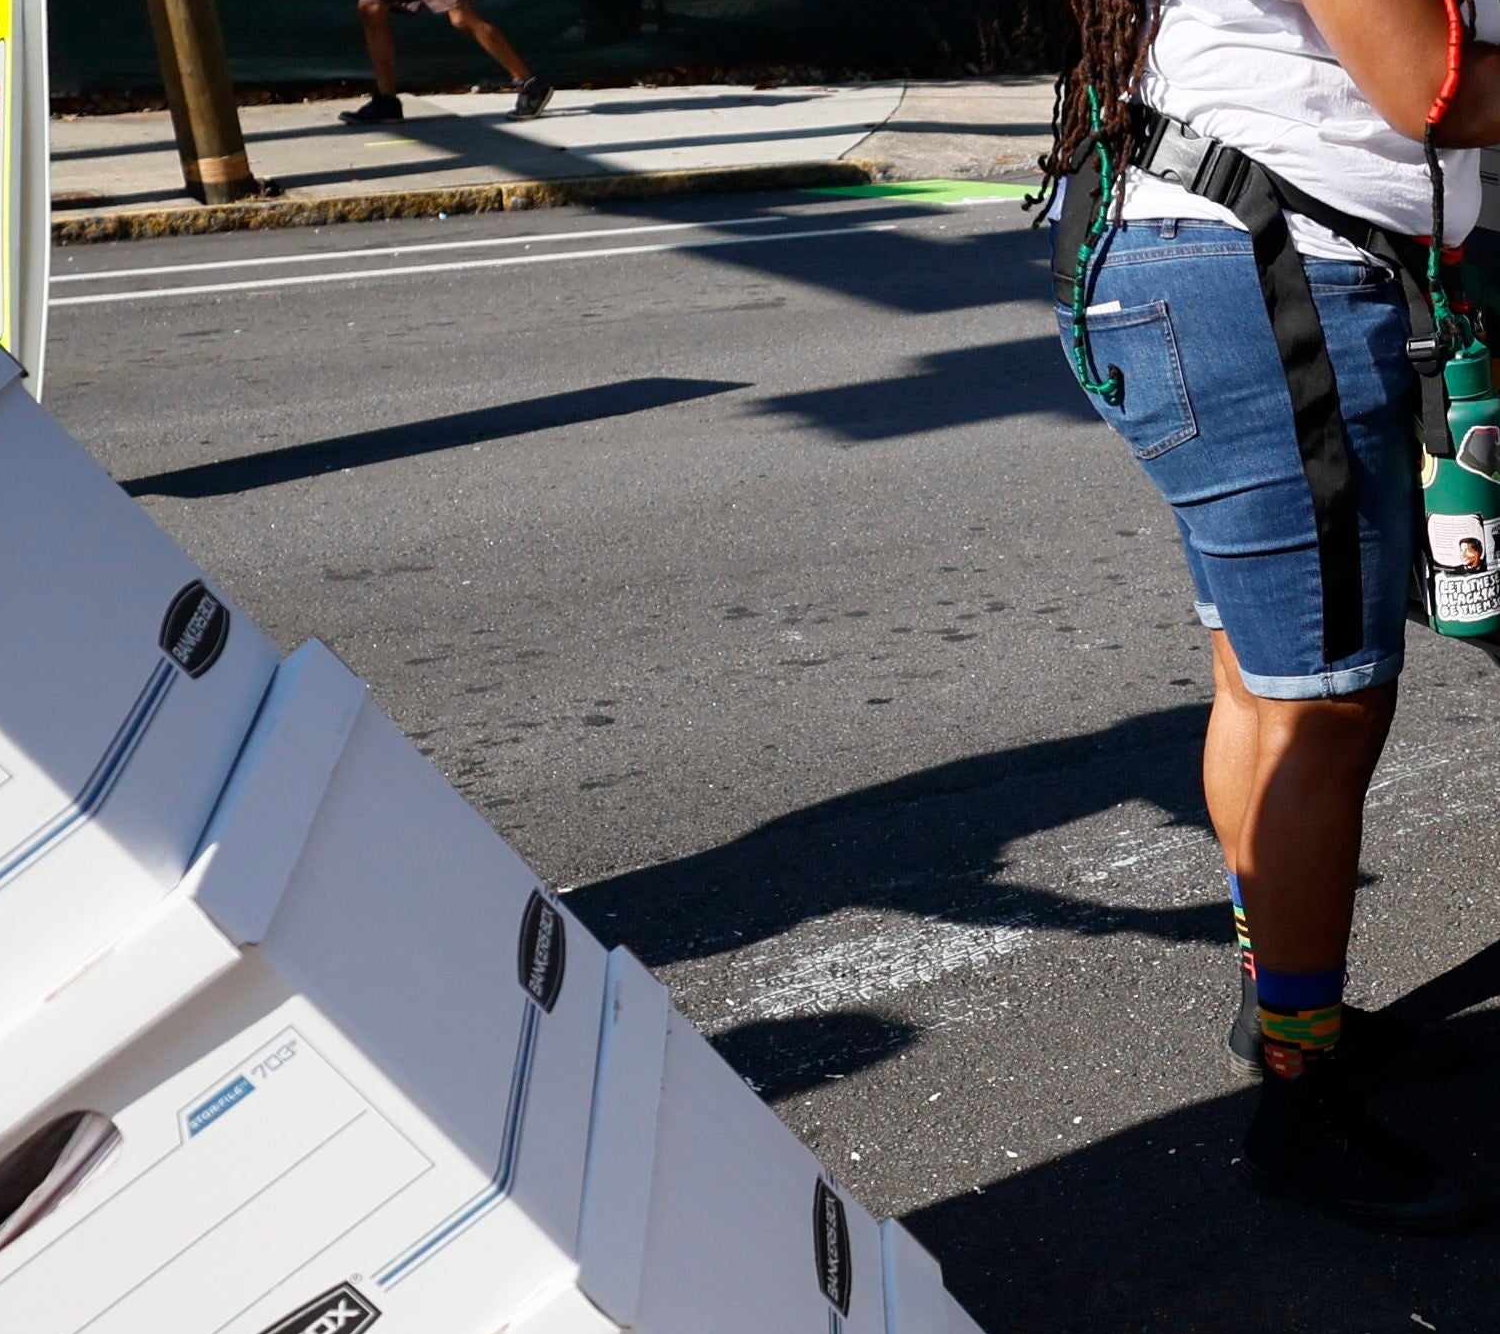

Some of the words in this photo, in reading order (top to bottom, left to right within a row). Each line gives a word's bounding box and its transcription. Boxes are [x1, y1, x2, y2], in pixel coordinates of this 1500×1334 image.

[1440, 580, 1463, 595] LET
[1468, 572, 1500, 590] THESE
[172, 611, 208, 664] BANKERS
[198, 592, 218, 620] BOX
[539, 903, 555, 938] BOX
[528, 929, 551, 998] BANKERS
